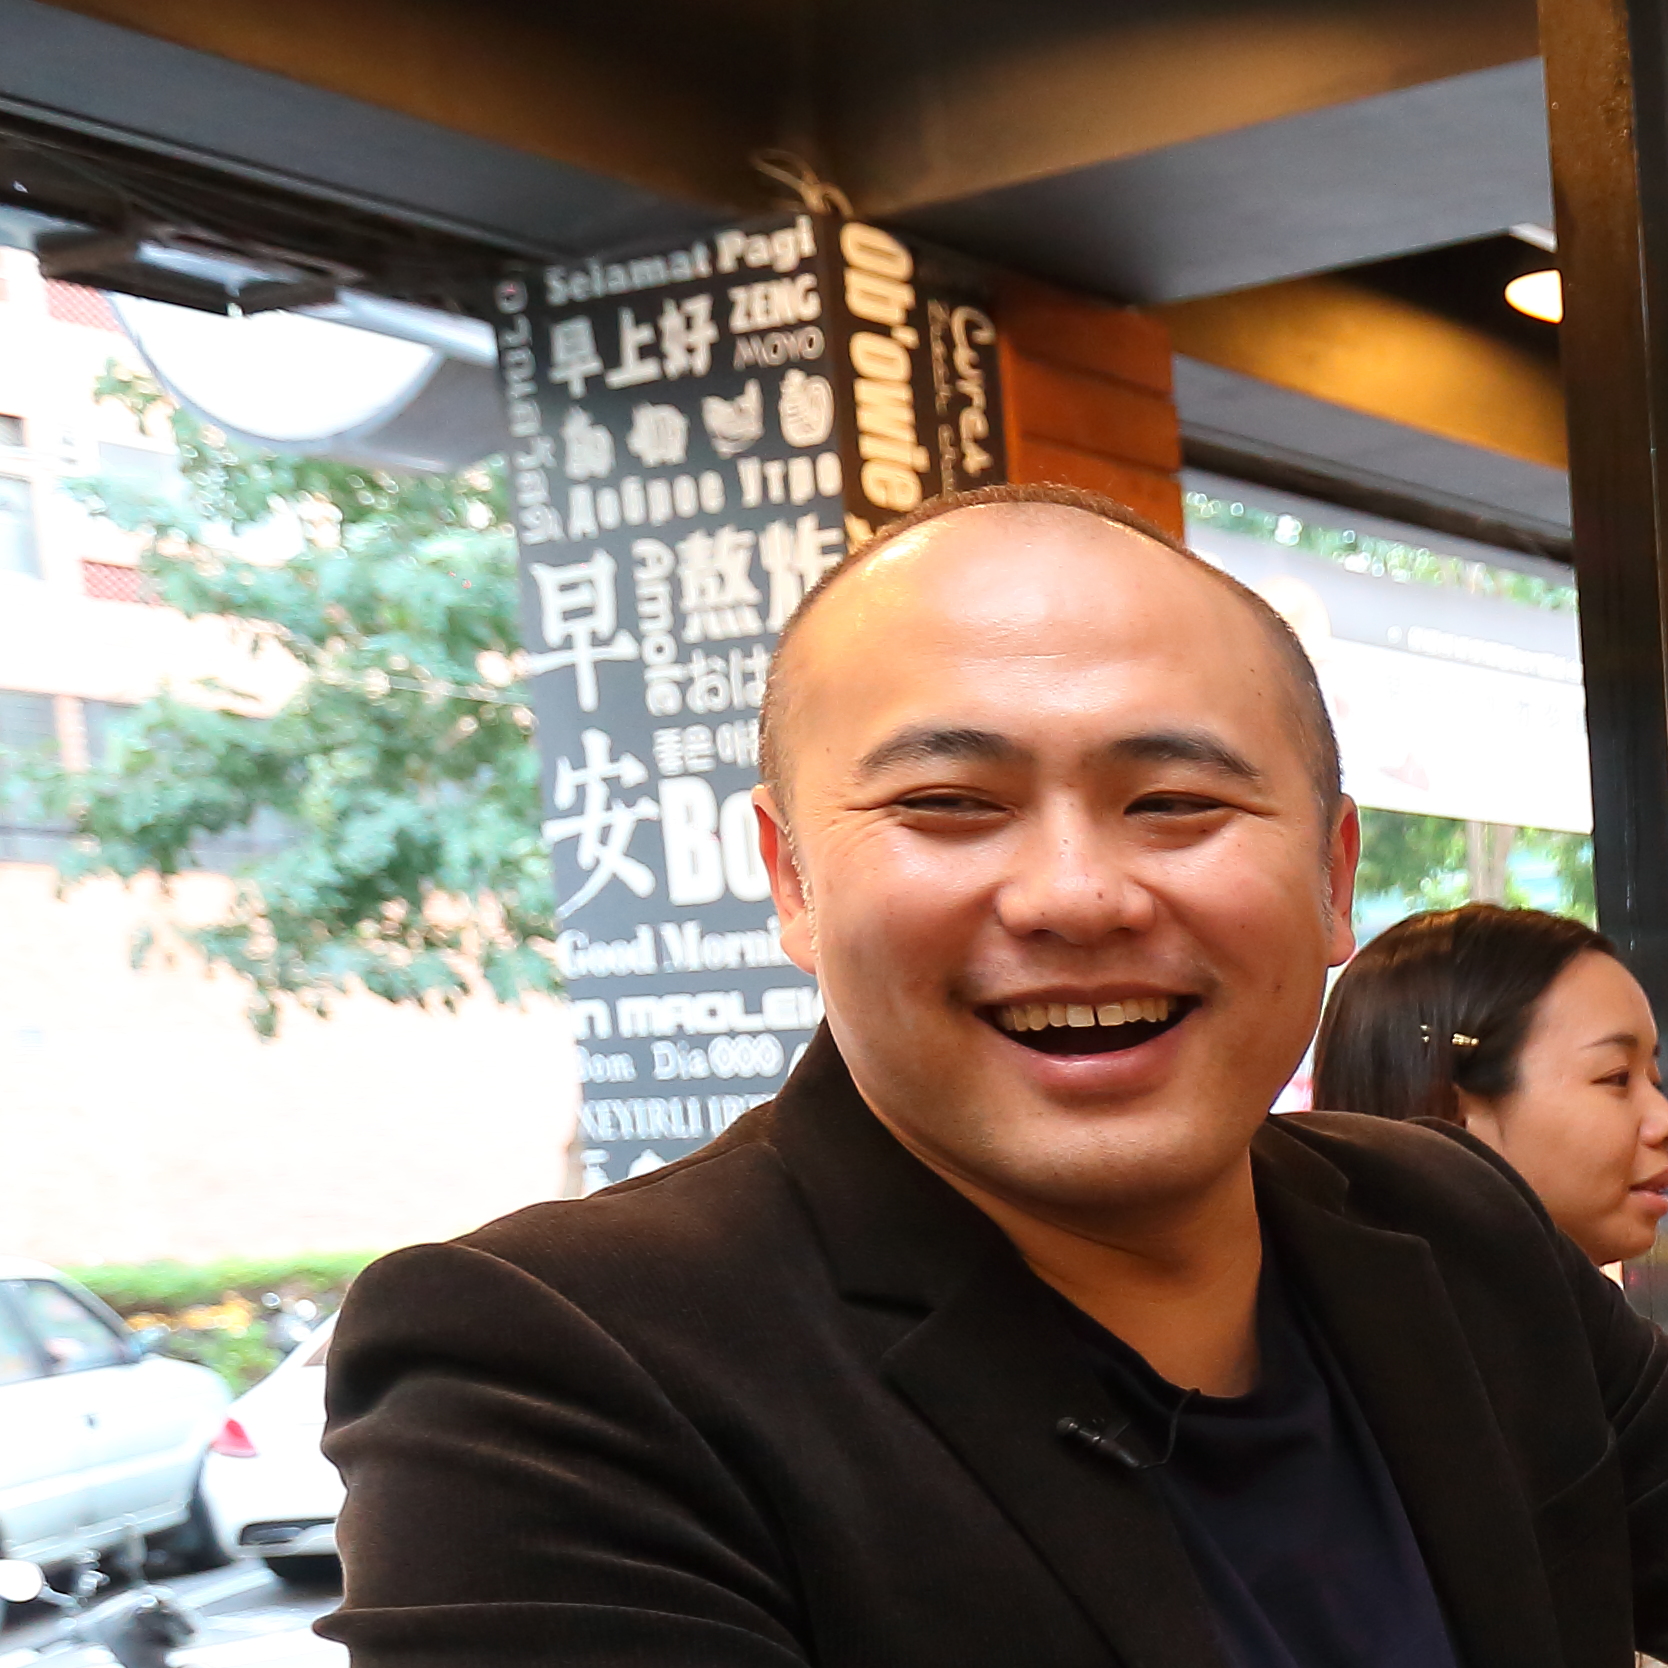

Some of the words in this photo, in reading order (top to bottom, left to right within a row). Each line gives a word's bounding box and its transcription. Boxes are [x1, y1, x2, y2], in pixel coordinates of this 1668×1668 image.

[544, 246, 713, 307] Selamat
[548, 293, 721, 399] 早上好
[523, 547, 660, 921] 早安
[555, 923, 658, 980] Good
